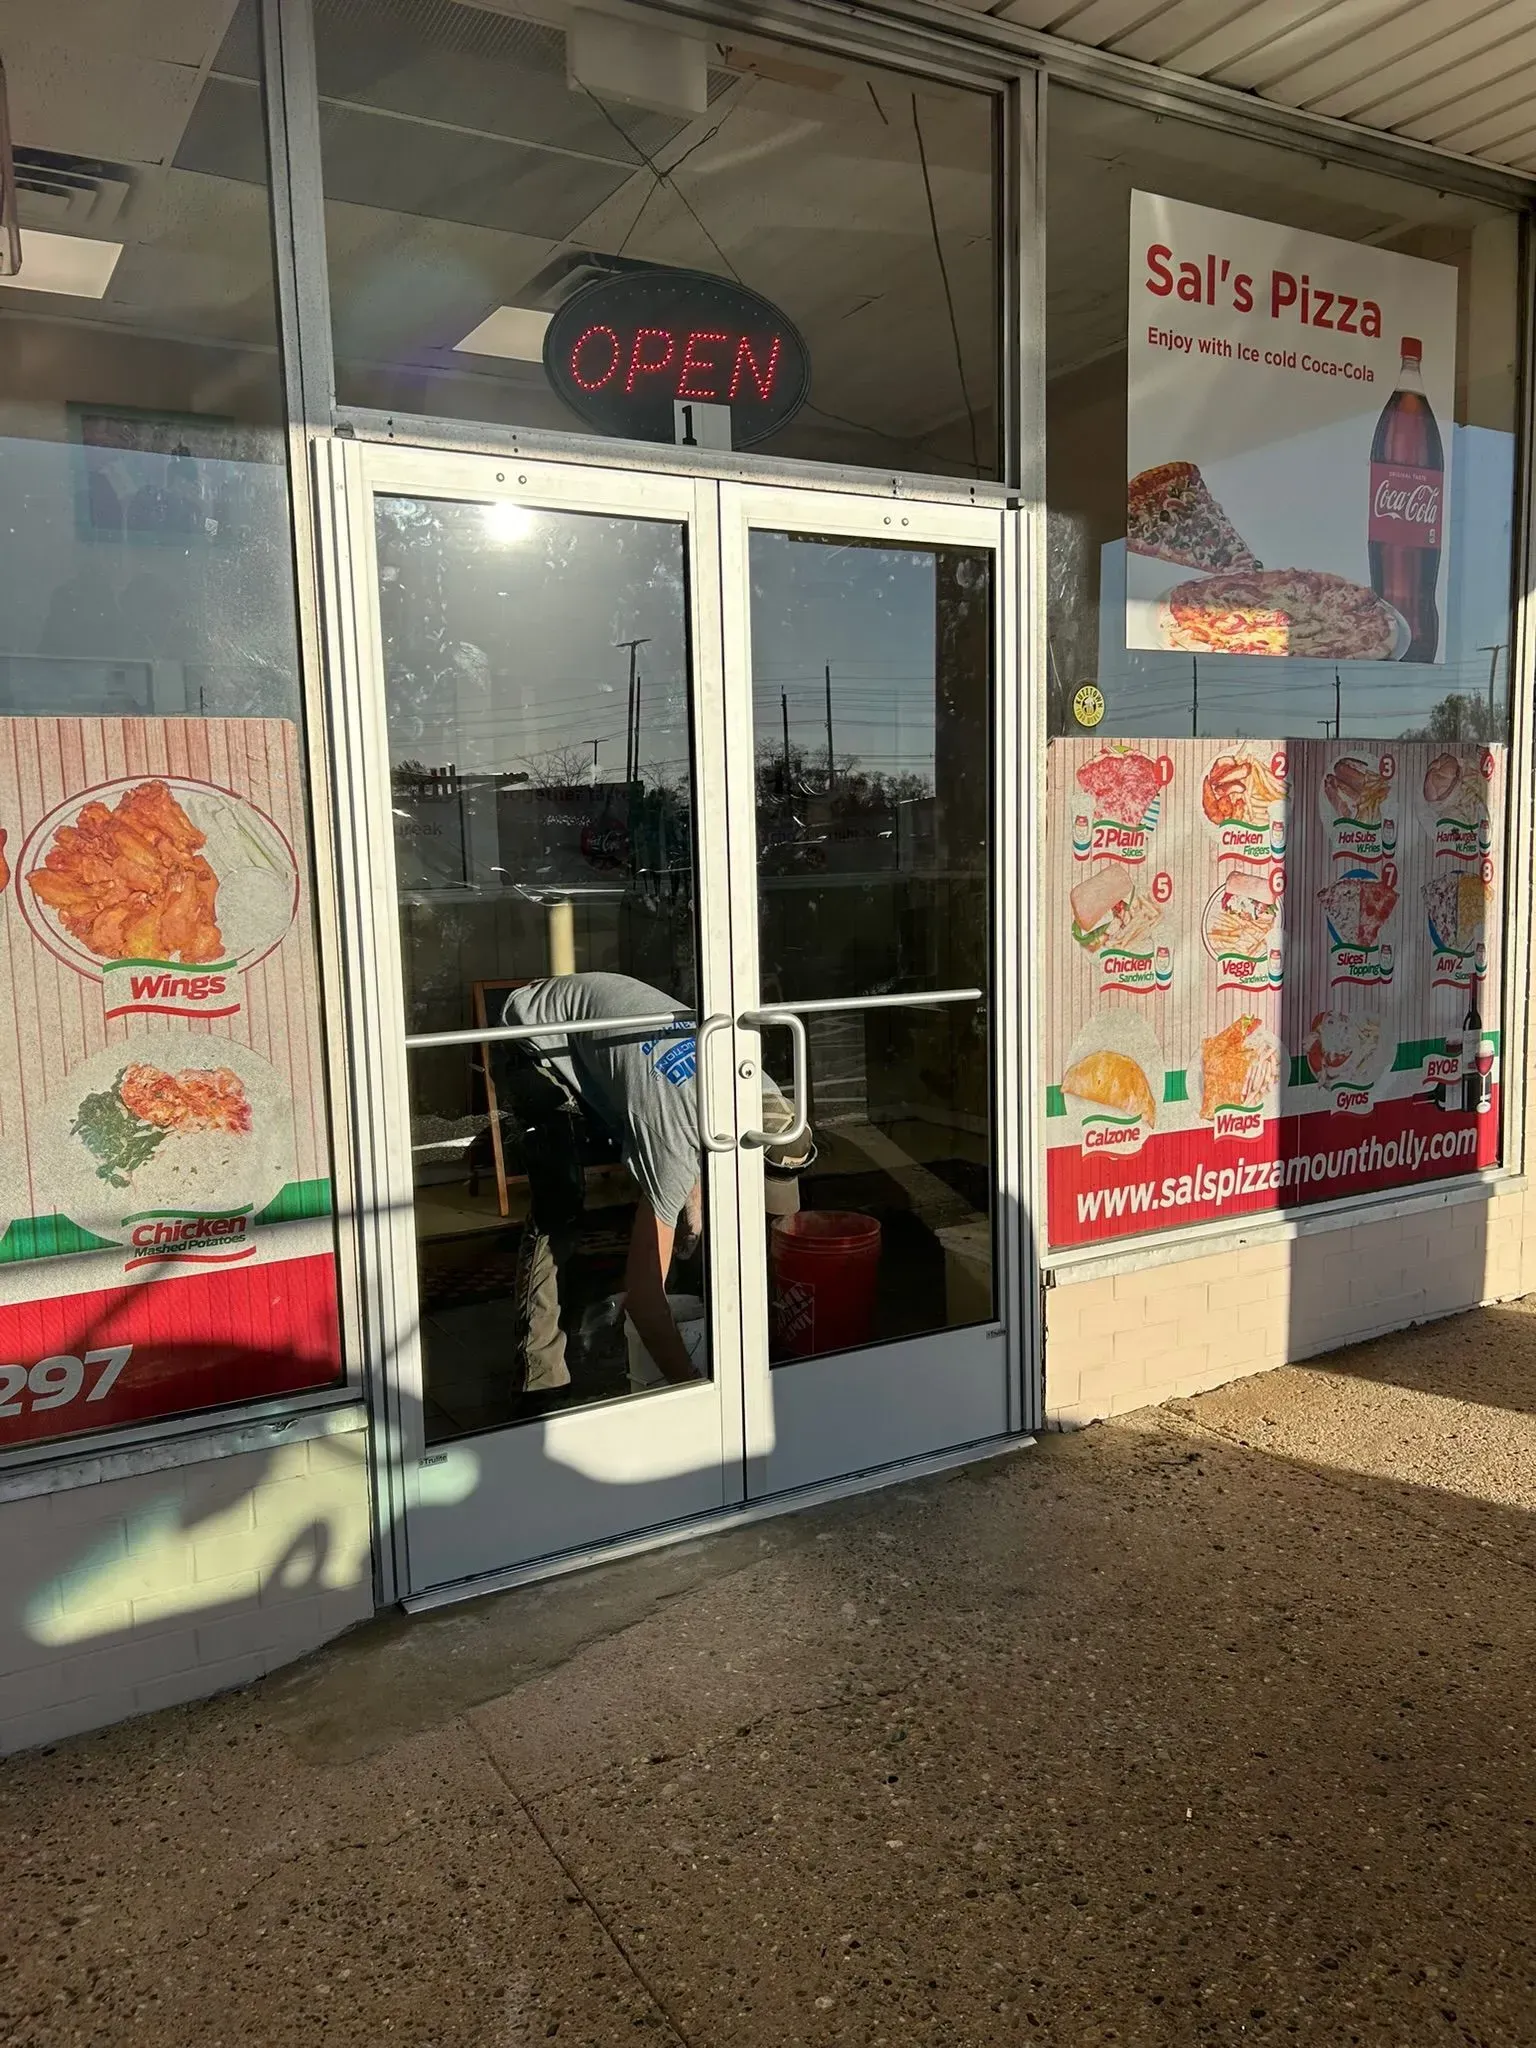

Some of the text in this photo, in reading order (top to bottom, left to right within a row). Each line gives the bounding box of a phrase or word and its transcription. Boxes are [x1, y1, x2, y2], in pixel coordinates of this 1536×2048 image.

[1145, 244, 1382, 339] Sal's Pizza
[570, 325, 782, 401] OPEN
[1148, 326, 1375, 383] Enjoy with Ice cold Coca-Cola
[681, 404, 698, 446] 1
[1374, 479, 1440, 524] Coca-Cola
[1159, 760, 1168, 782] 1
[1273, 756, 1287, 777] 2
[1381, 757, 1393, 777] 3
[1483, 756, 1493, 775] 4
[1093, 827, 1145, 848] 2 Plain
[1222, 830, 1264, 846] Chicken
[1338, 831, 1377, 844] Hot Subs
[1121, 847, 1145, 858] Slices
[1243, 845, 1271, 857] Fingers
[1272, 870, 1285, 890] 6
[1384, 867, 1395, 887] 7
[1483, 862, 1491, 879] 8
[1157, 878, 1169, 897] 5
[1104, 957, 1153, 975] Chicken
[1222, 959, 1257, 978] Veggy
[1337, 952, 1363, 967] Slices
[1436, 956, 1464, 973] Any 2
[1118, 971, 1154, 983] Sandwich
[1238, 973, 1269, 985] Sandwich
[1349, 963, 1380, 977] Topping
[130, 973, 226, 1001] Wings
[1427, 1058, 1459, 1076] BYOB
[1336, 1091, 1369, 1110] Gyros
[1217, 1113, 1261, 1134] Wraps
[1085, 1126, 1141, 1148] Calzone
[1077, 1127, 1478, 1224] www.salspizzamountholly.com
[132, 1215, 247, 1247] Chicken
[134, 1234, 246, 1258] Mashed Potatoes
